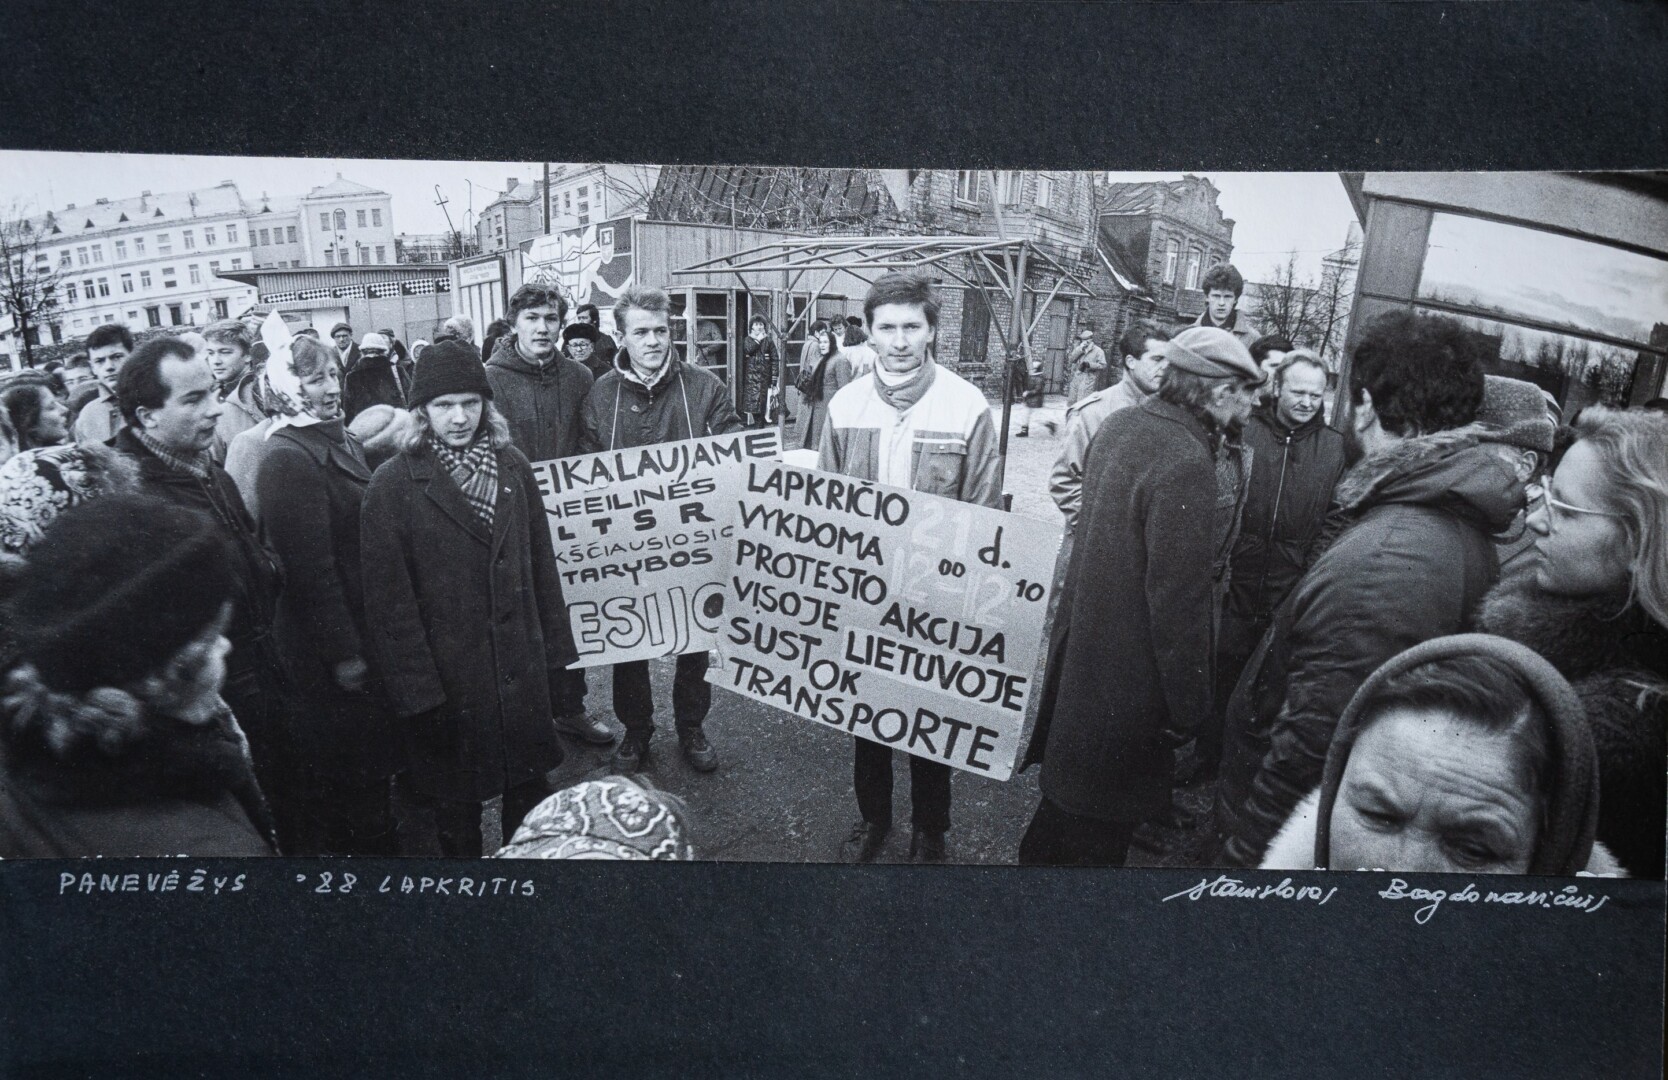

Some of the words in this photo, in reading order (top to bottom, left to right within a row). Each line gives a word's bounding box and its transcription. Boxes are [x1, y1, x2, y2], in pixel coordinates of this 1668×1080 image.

[748, 463, 910, 526] LAPKRIČIO
[739, 500, 884, 566] VYKDOMA
[562, 548, 713, 586] TARYBOS
[736, 539, 887, 605] PROTESTO
[880, 602, 1005, 663] AKCIJA
[845, 631, 1027, 711] LIETUVOJE
[729, 657, 999, 771] TRANSPORTE
[379, 875, 535, 896] LAPKRITIS
